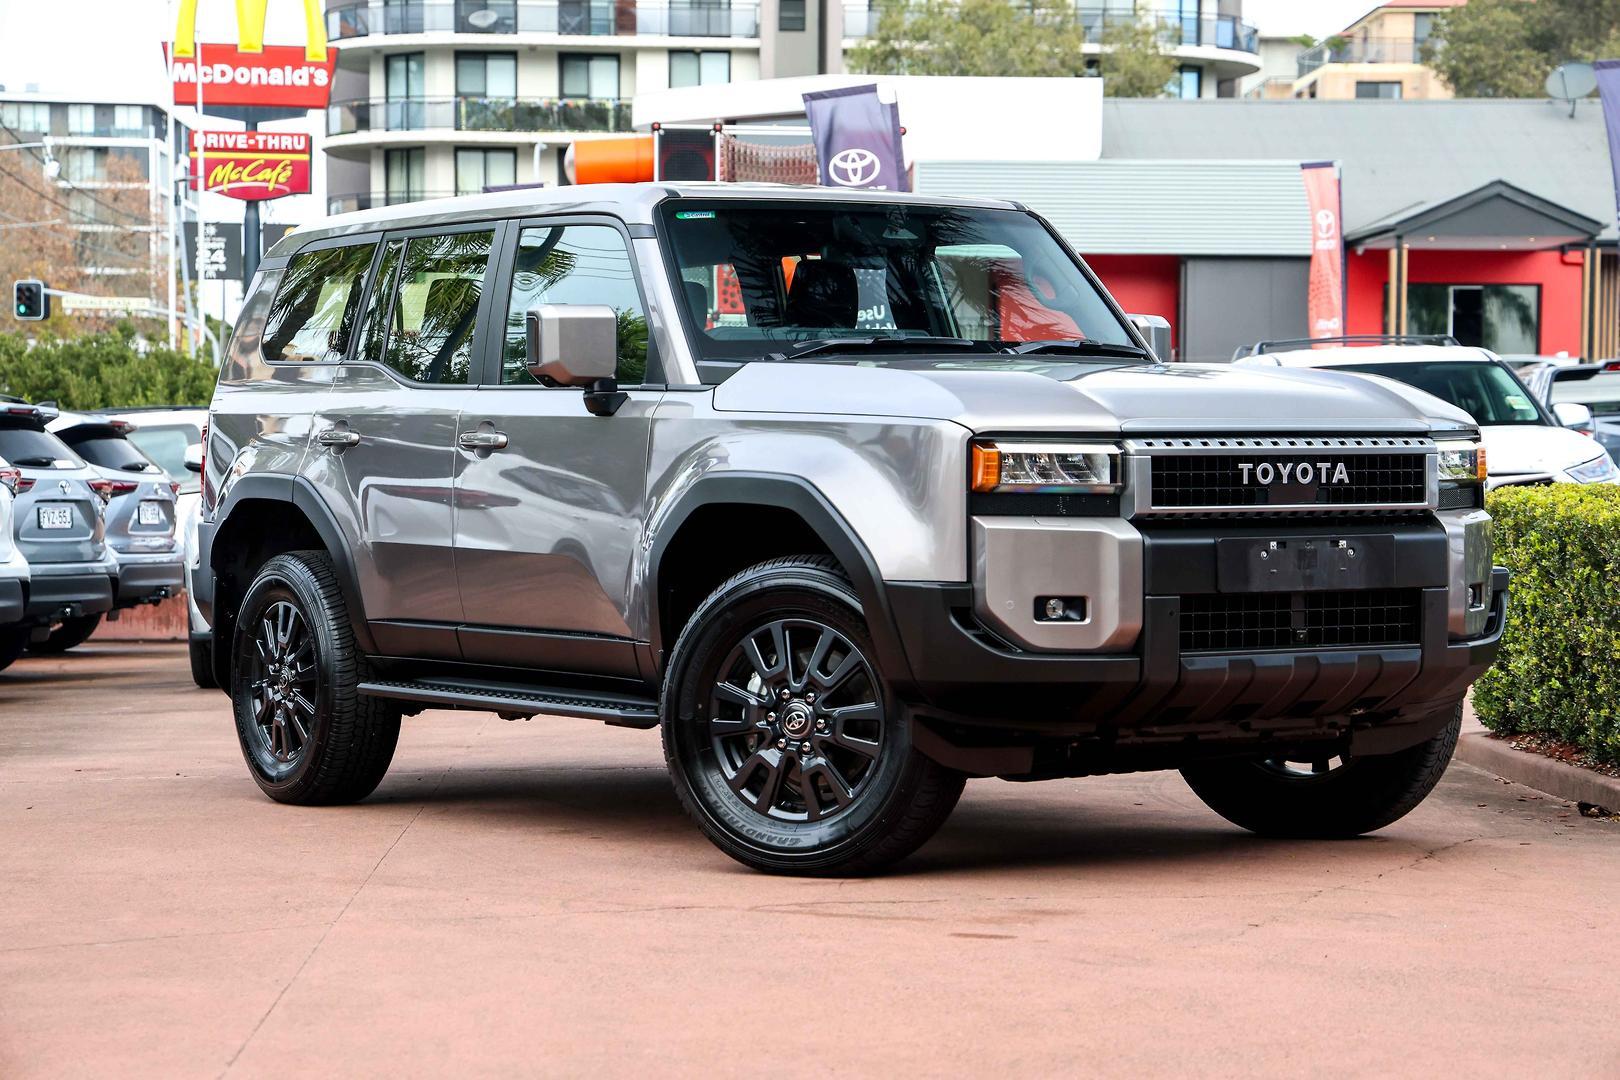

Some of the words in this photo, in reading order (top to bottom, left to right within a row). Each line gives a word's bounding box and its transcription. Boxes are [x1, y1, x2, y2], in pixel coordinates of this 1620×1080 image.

[173, 62, 329, 87] McDonald's
[1237, 462, 1350, 485] TOYOTA
[711, 799, 803, 847] GRANDTREK
